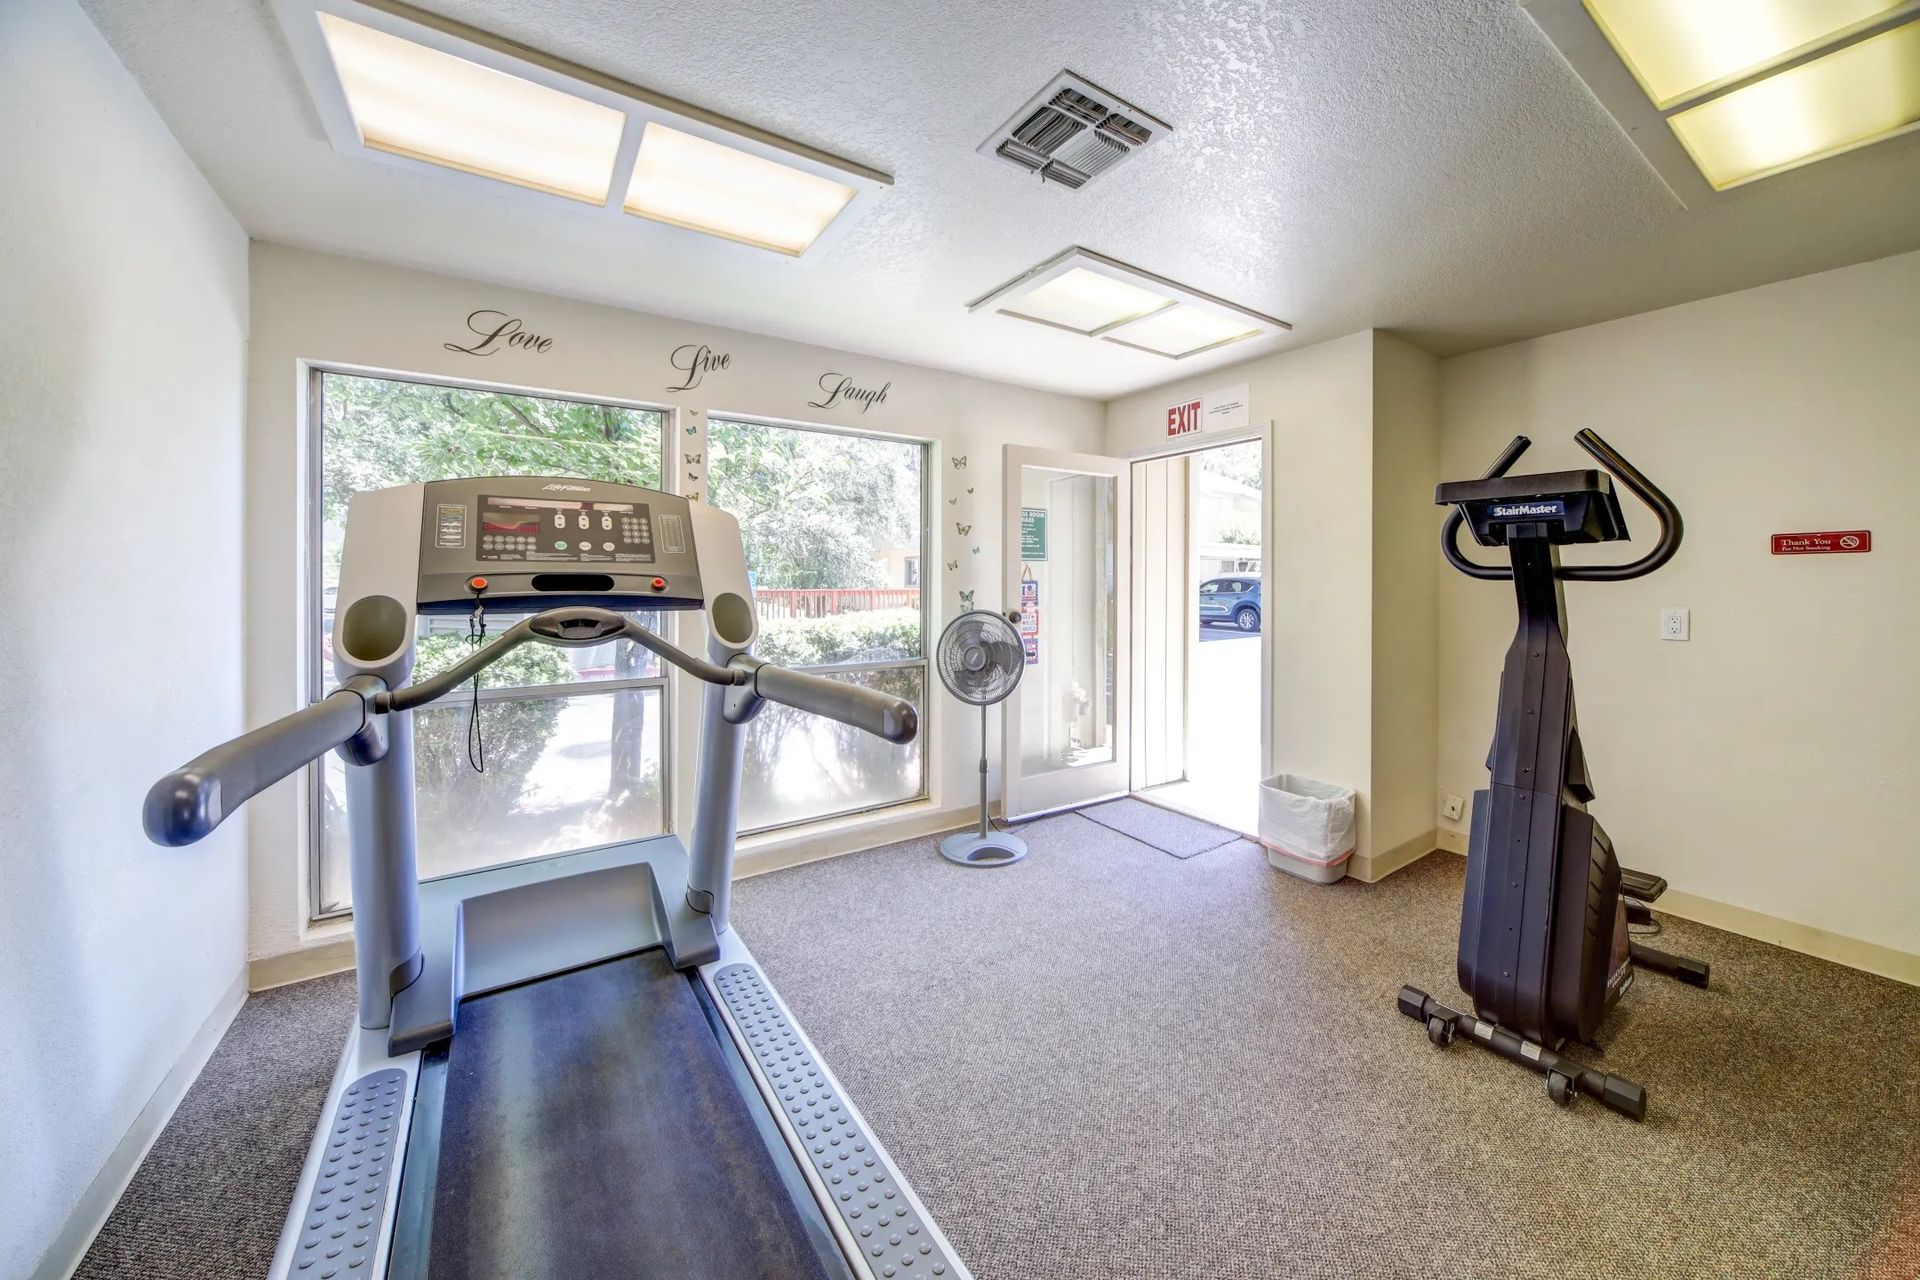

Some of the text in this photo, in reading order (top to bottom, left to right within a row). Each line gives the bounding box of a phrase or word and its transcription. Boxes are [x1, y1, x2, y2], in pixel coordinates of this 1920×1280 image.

[444, 309, 553, 356] Love
[665, 345, 731, 393] Live
[808, 372, 892, 414] Laugh
[1167, 401, 1201, 437] EXIT
[1493, 504, 1558, 517] StairMaster
[1781, 538, 1832, 546] Thank You
